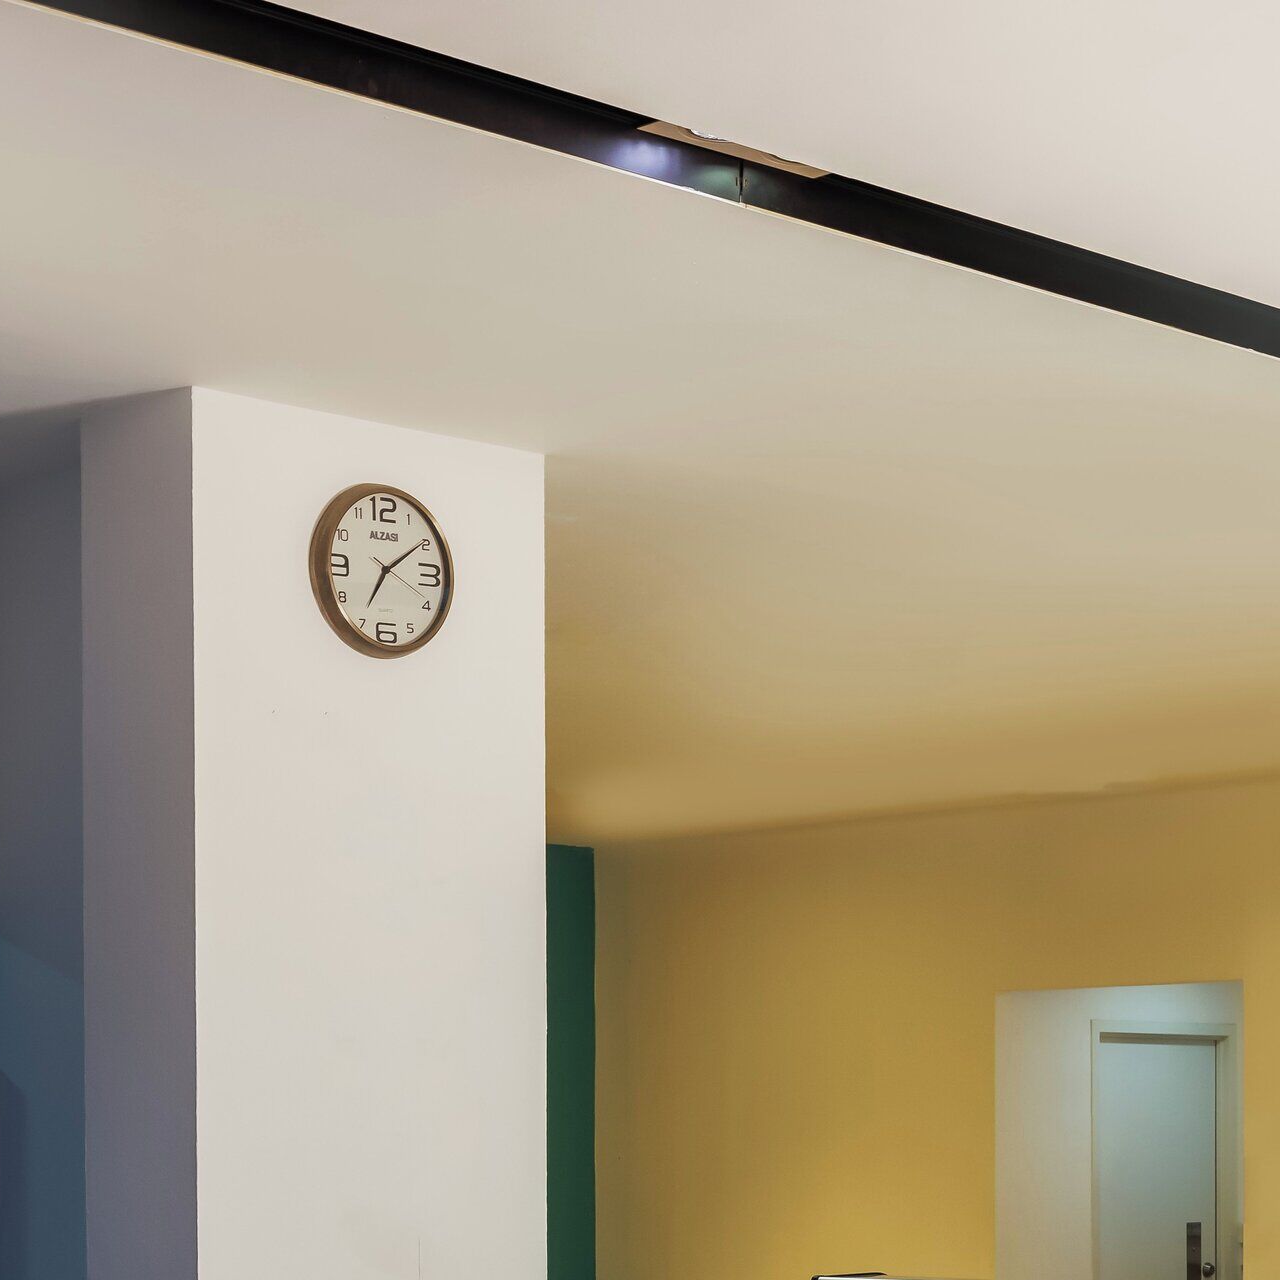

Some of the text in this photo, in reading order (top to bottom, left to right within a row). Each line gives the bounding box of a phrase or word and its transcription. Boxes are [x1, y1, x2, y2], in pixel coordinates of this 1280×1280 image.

[354, 507, 363, 520] 11
[369, 495, 397, 524] 12
[406, 513, 411, 525] 1
[336, 528, 349, 542] 10
[421, 538, 431, 551] 2
[331, 552, 349, 577] 9
[418, 562, 441, 588] 3
[338, 591, 347, 603] 8
[421, 600, 431, 612] 4
[358, 618, 366, 629] 7
[406, 623, 414, 634] 5
[375, 622, 398, 644] 6
